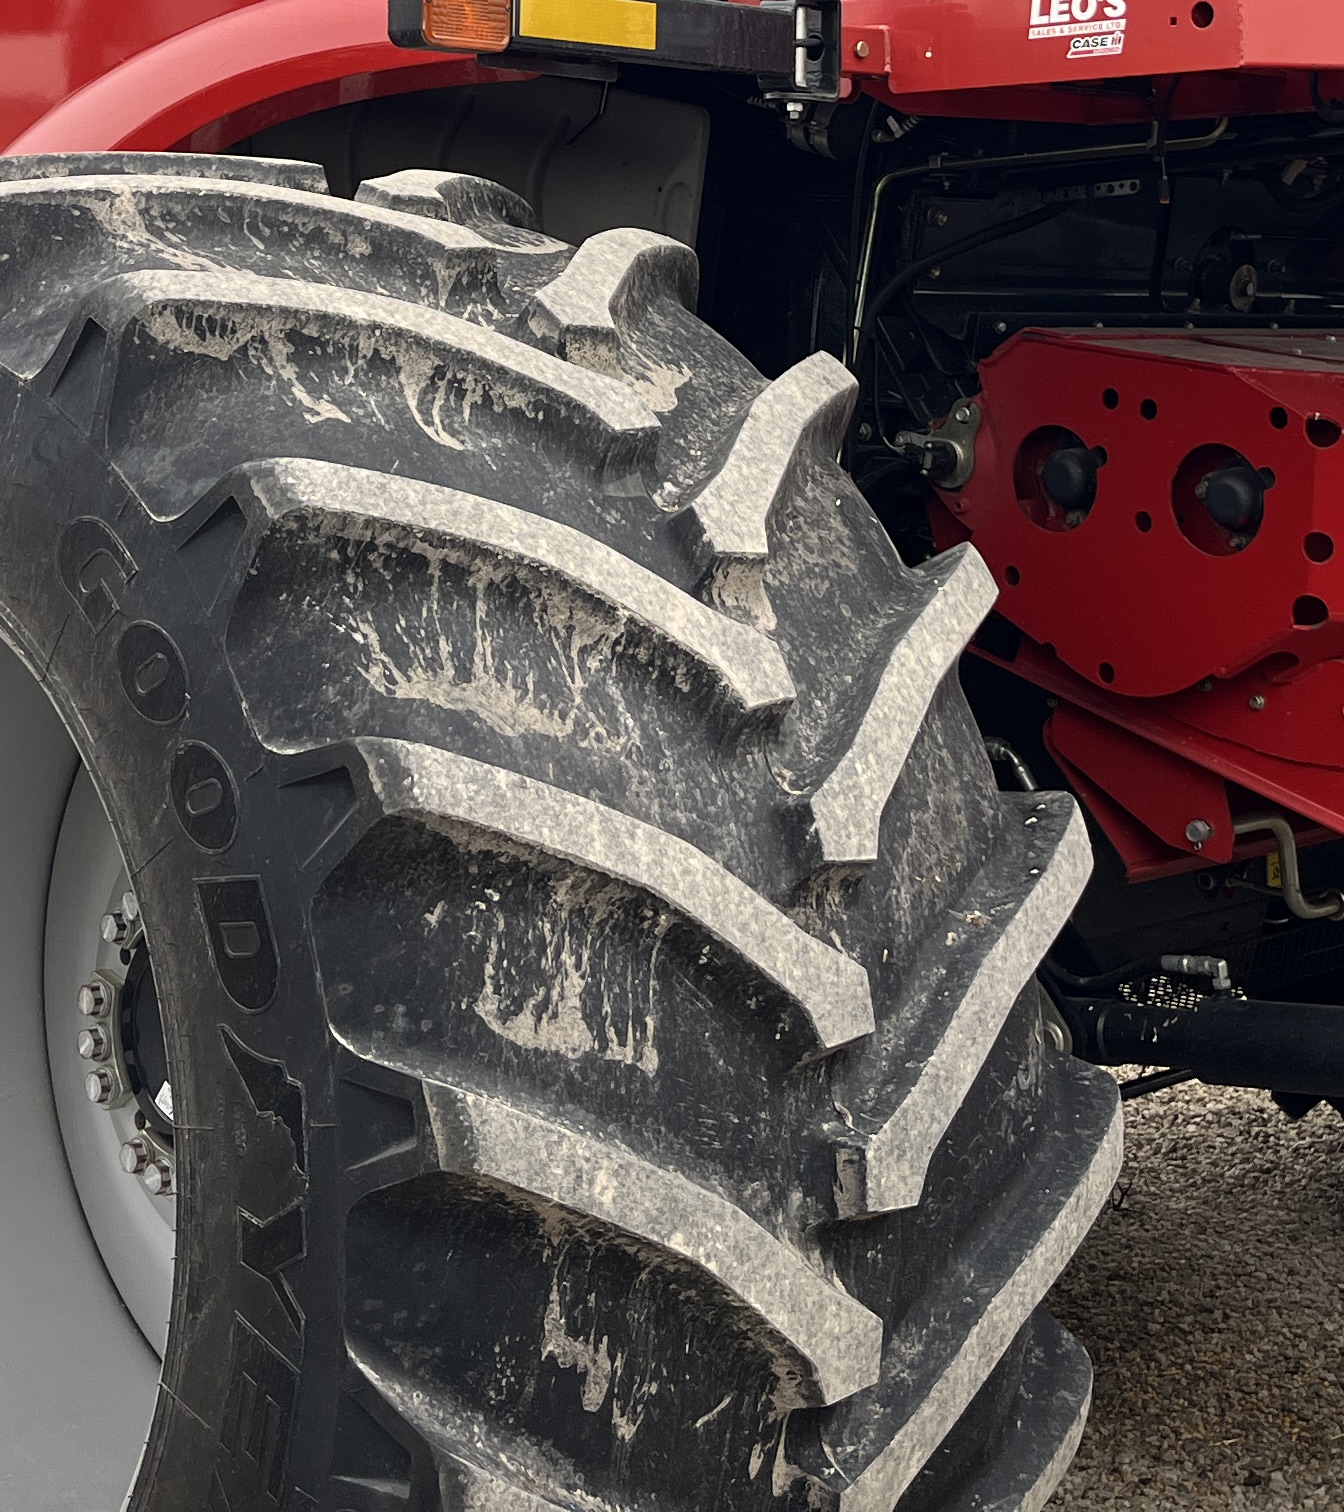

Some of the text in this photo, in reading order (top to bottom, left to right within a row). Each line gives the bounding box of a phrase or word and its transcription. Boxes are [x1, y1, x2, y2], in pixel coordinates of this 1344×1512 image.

[1030, 27, 1056, 37] SALES
[1059, 26, 1065, 34] &
[1072, 37, 1109, 49] CASE
